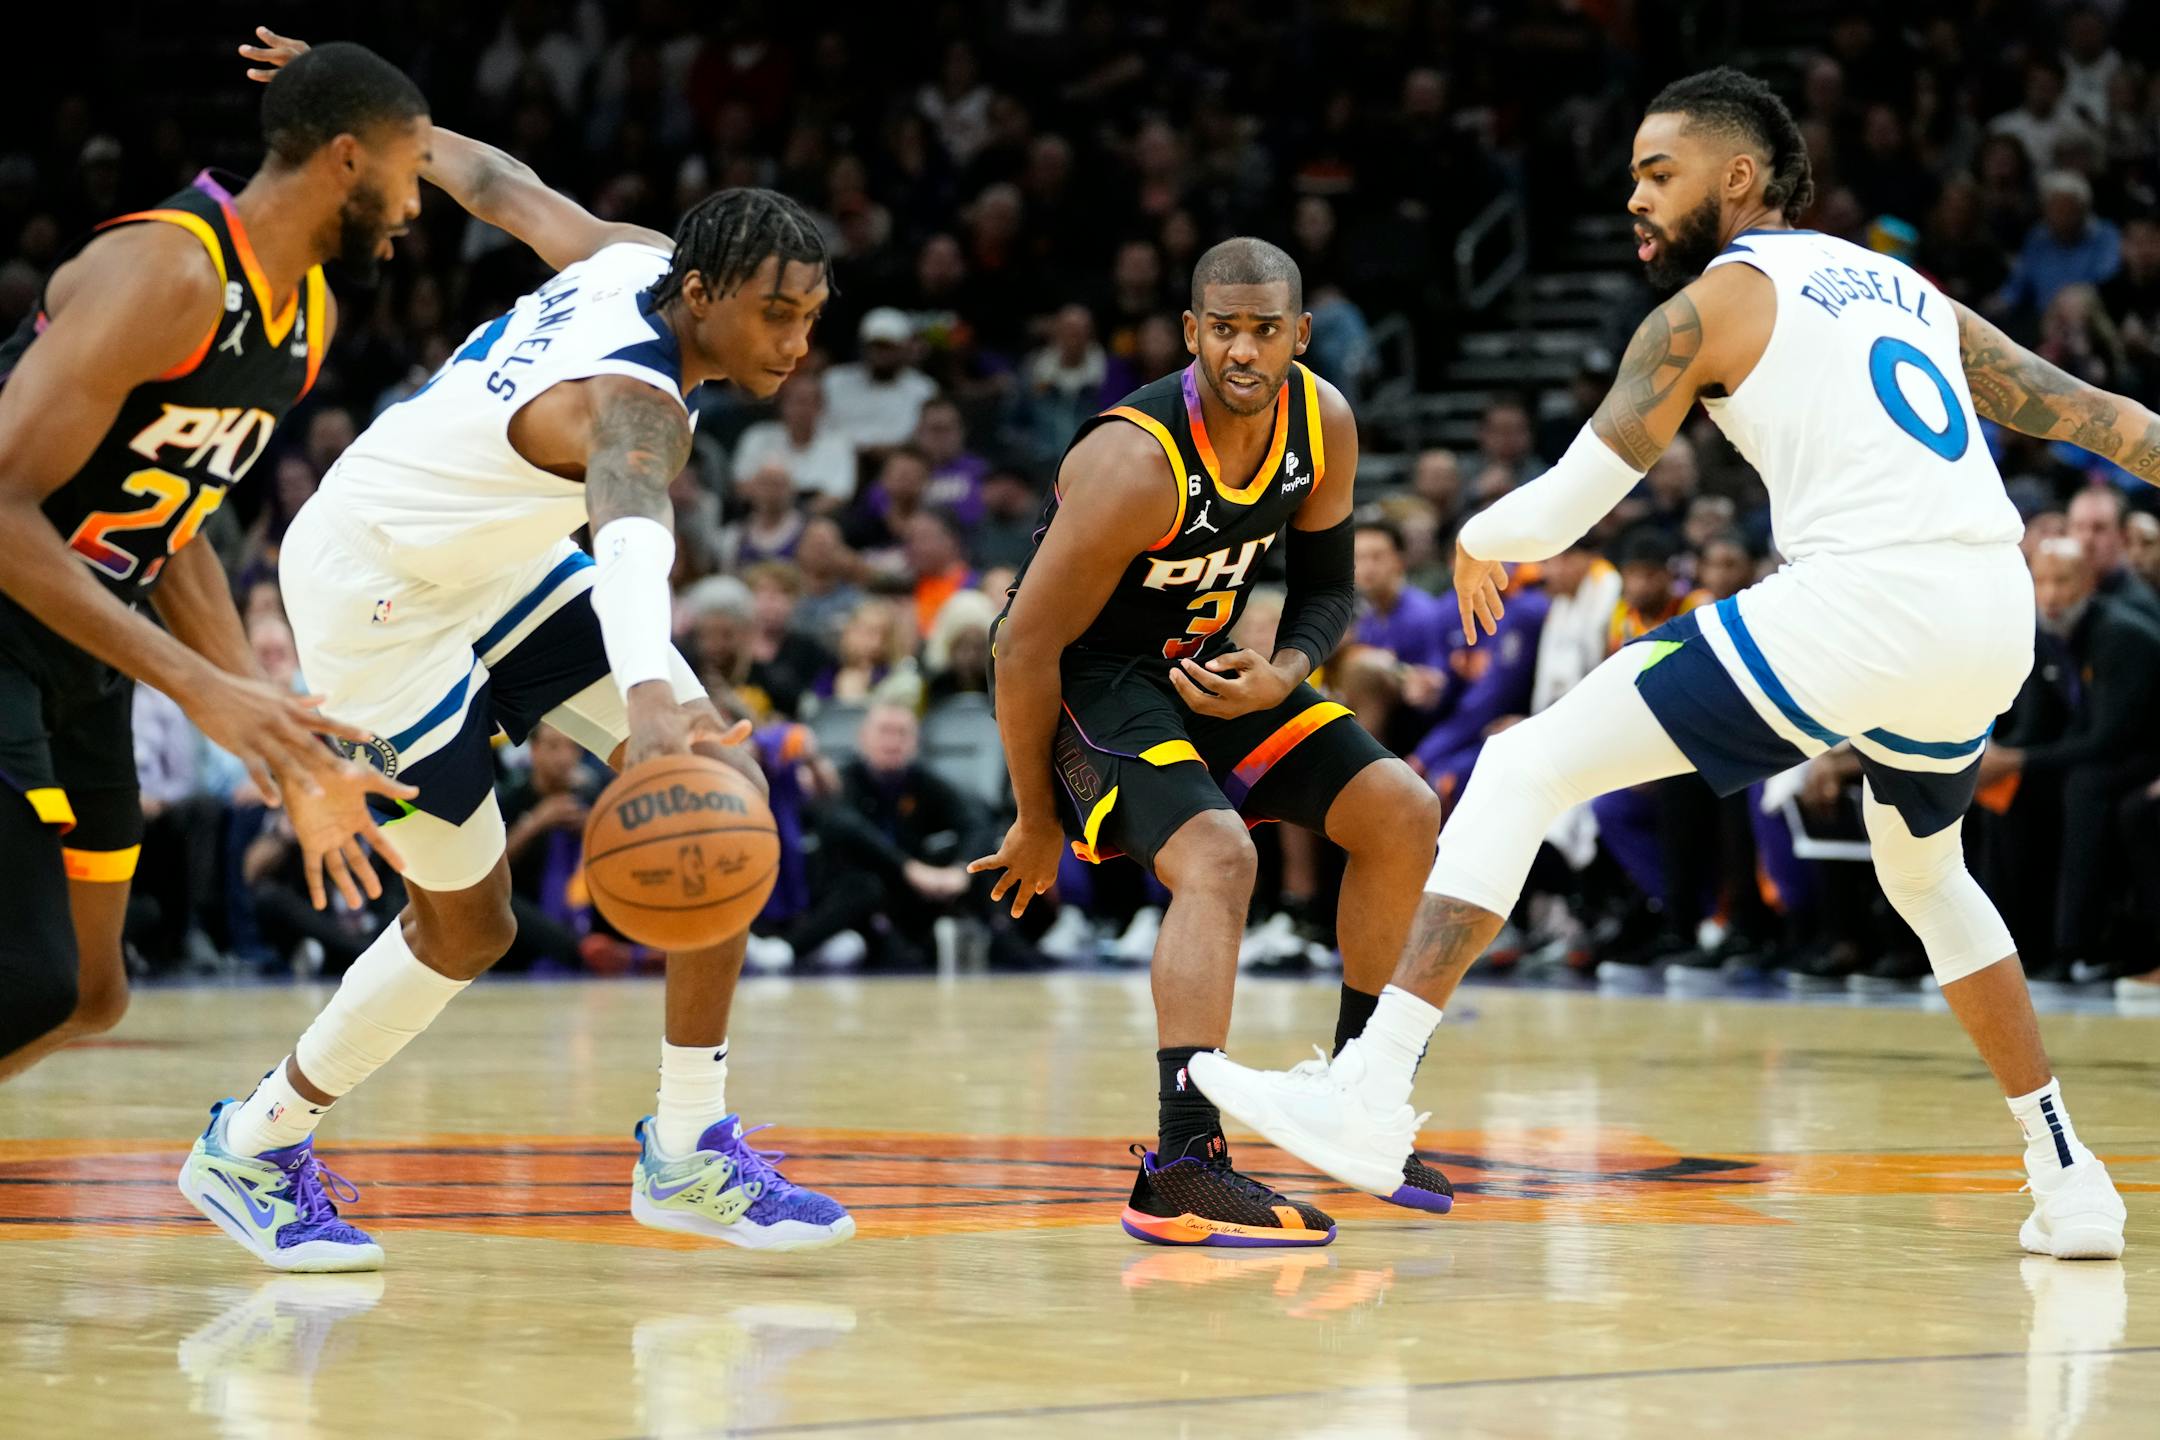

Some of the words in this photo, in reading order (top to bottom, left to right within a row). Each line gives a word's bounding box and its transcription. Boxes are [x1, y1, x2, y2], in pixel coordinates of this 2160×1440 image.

[224, 280, 243, 312] 6
[1801, 267, 1931, 327] RUSSELL
[1869, 336, 1969, 463] 0
[1188, 474, 1202, 497] 6
[1281, 473, 1310, 494] PayPal
[1143, 531, 1276, 592] PH
[1162, 590, 1237, 660] 3
[617, 784, 748, 830] Wilson
